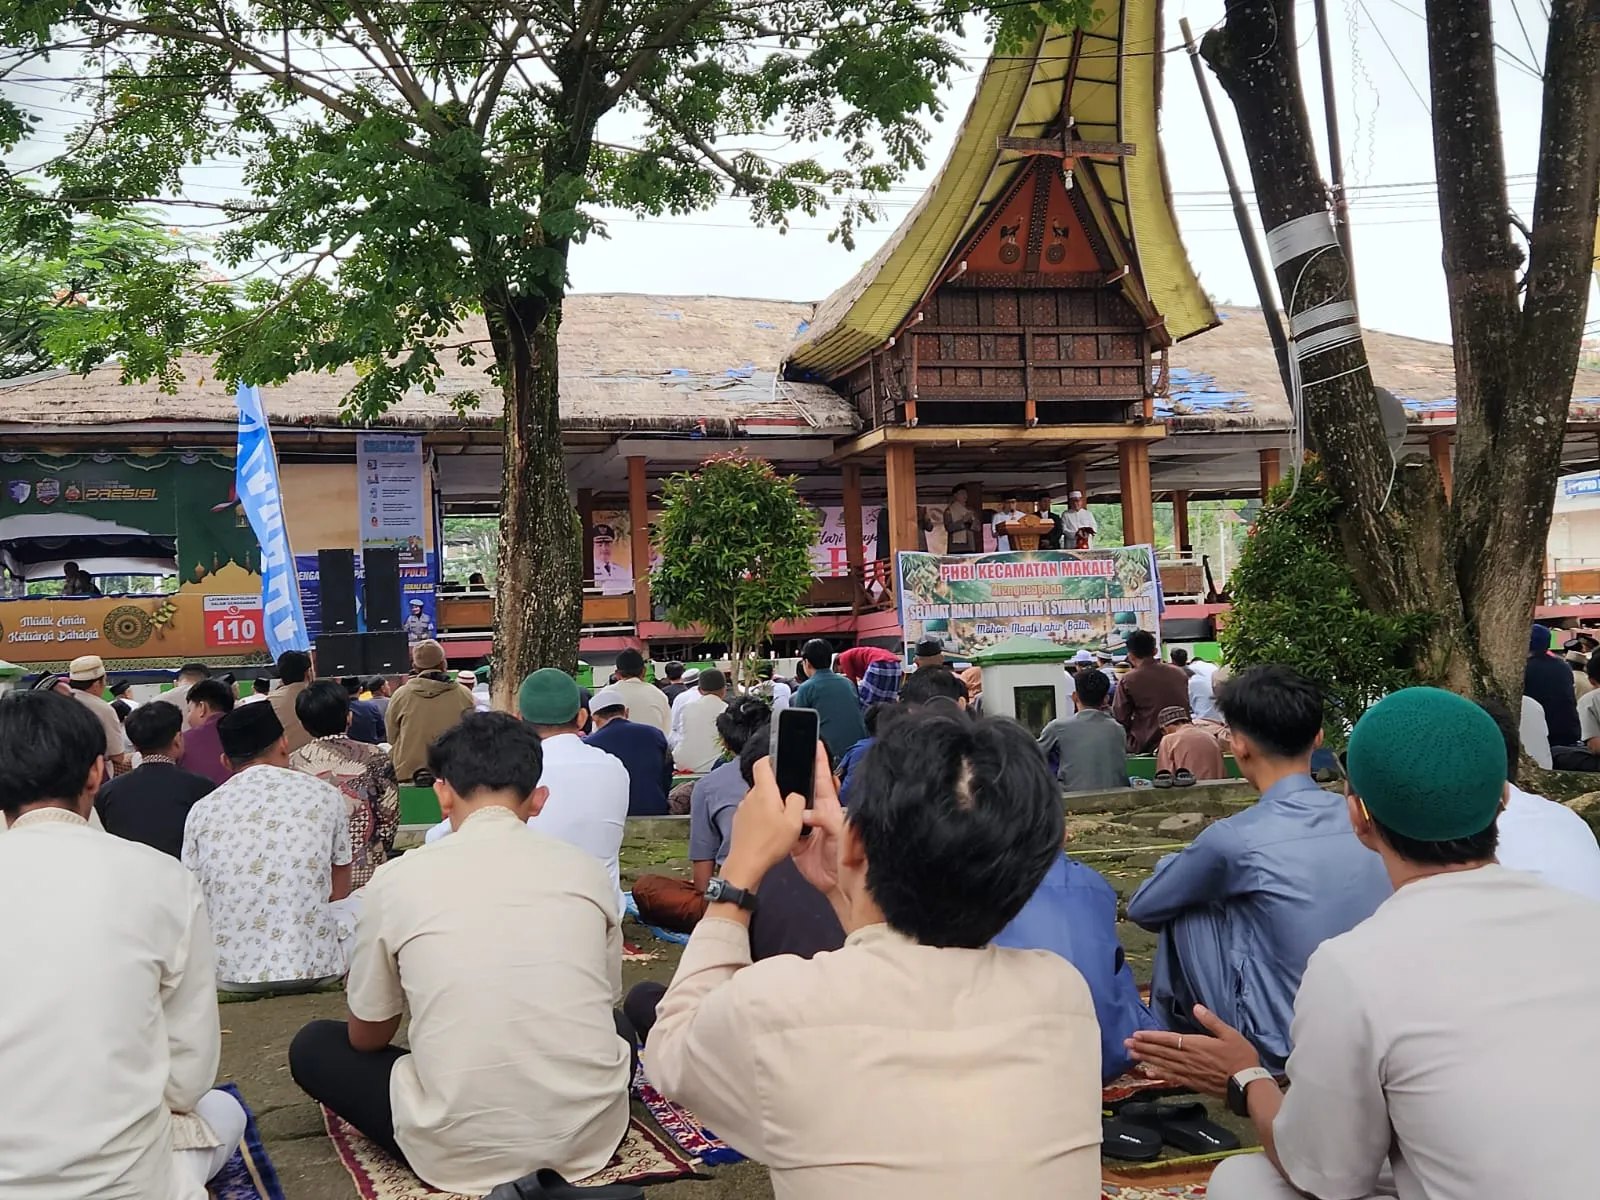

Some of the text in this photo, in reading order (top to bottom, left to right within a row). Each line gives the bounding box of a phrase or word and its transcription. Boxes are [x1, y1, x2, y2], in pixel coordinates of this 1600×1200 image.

[86, 488, 157, 498] PRESISI
[941, 560, 1114, 580] PHBI KECAMATAN MAKALE
[991, 583, 1064, 599] Mengucapkan
[910, 604, 950, 620] SELAMAT
[951, 603, 973, 619] HARI
[975, 602, 998, 618] RAYA
[999, 601, 1020, 617] IDUL
[1021, 600, 1044, 617] FITRI
[1051, 598, 1086, 614] SYAWAL
[20, 615, 86, 627] Mudik Aman
[8, 629, 99, 643] Keluarga Bahagia
[212, 619, 256, 640] 110
[976, 624, 1007, 635] Mohon
